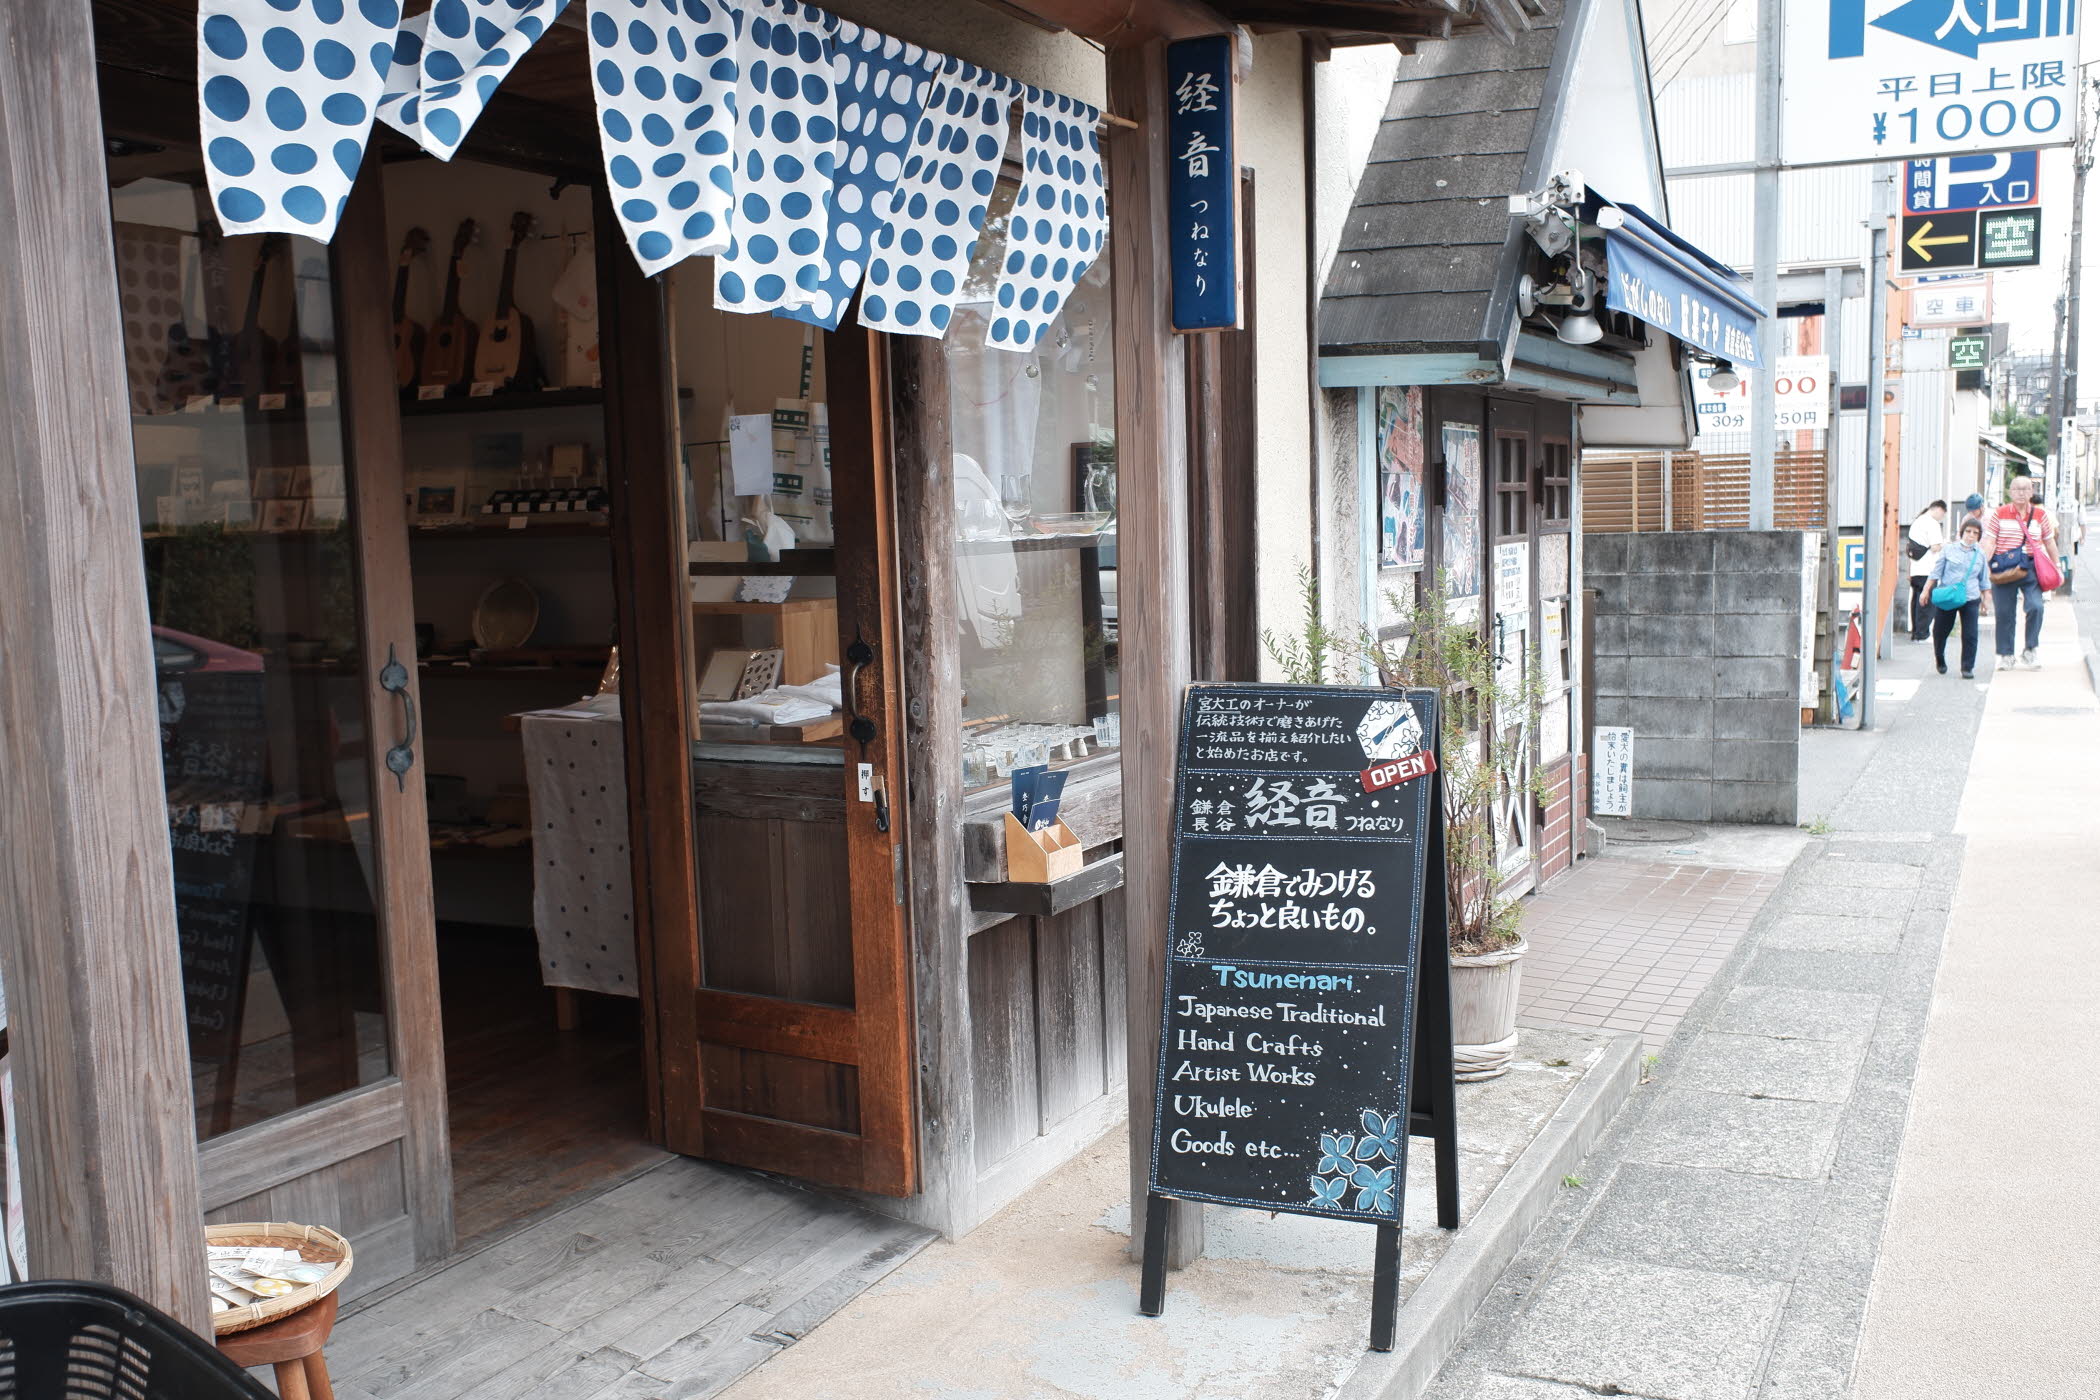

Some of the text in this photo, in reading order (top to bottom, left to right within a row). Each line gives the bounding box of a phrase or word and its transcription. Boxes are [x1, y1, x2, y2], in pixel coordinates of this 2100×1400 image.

[1877, 61, 2066, 101] 平日上限
[1873, 96, 2061, 145] ¥1000
[1176, 72, 1220, 297] 経音 つねなり
[1979, 181, 2029, 205] 入口
[1985, 215, 2035, 260] 空
[1927, 296, 1974, 316] 空車
[1952, 336, 1985, 368] 空
[1198, 697, 1312, 712] 宮大工のオーナーが
[1195, 715, 1343, 729] 伝統技術で磨きあげた
[1195, 730, 1352, 745] 一流品を揃え紹介したい
[1195, 746, 1308, 763] と始めたお店です。
[1370, 755, 1427, 786] OPEN
[1189, 799, 1236, 816] 鎌倉
[1245, 777, 1403, 832] 経音 つねなり
[1192, 817, 1236, 832] 長谷
[1205, 862, 1376, 899] 鎌倉でみつける
[1209, 899, 1376, 935] ちょっと良いもの。
[1212, 965, 1353, 991] Tsunenari
[1177, 995, 1386, 1027] Japanese Traditional
[1177, 1030, 1323, 1056] Hand Crafts
[1172, 1061, 1316, 1086] Artist Works
[1174, 1094, 1253, 1118] Ukulele
[1171, 1128, 1235, 1156] Goods
